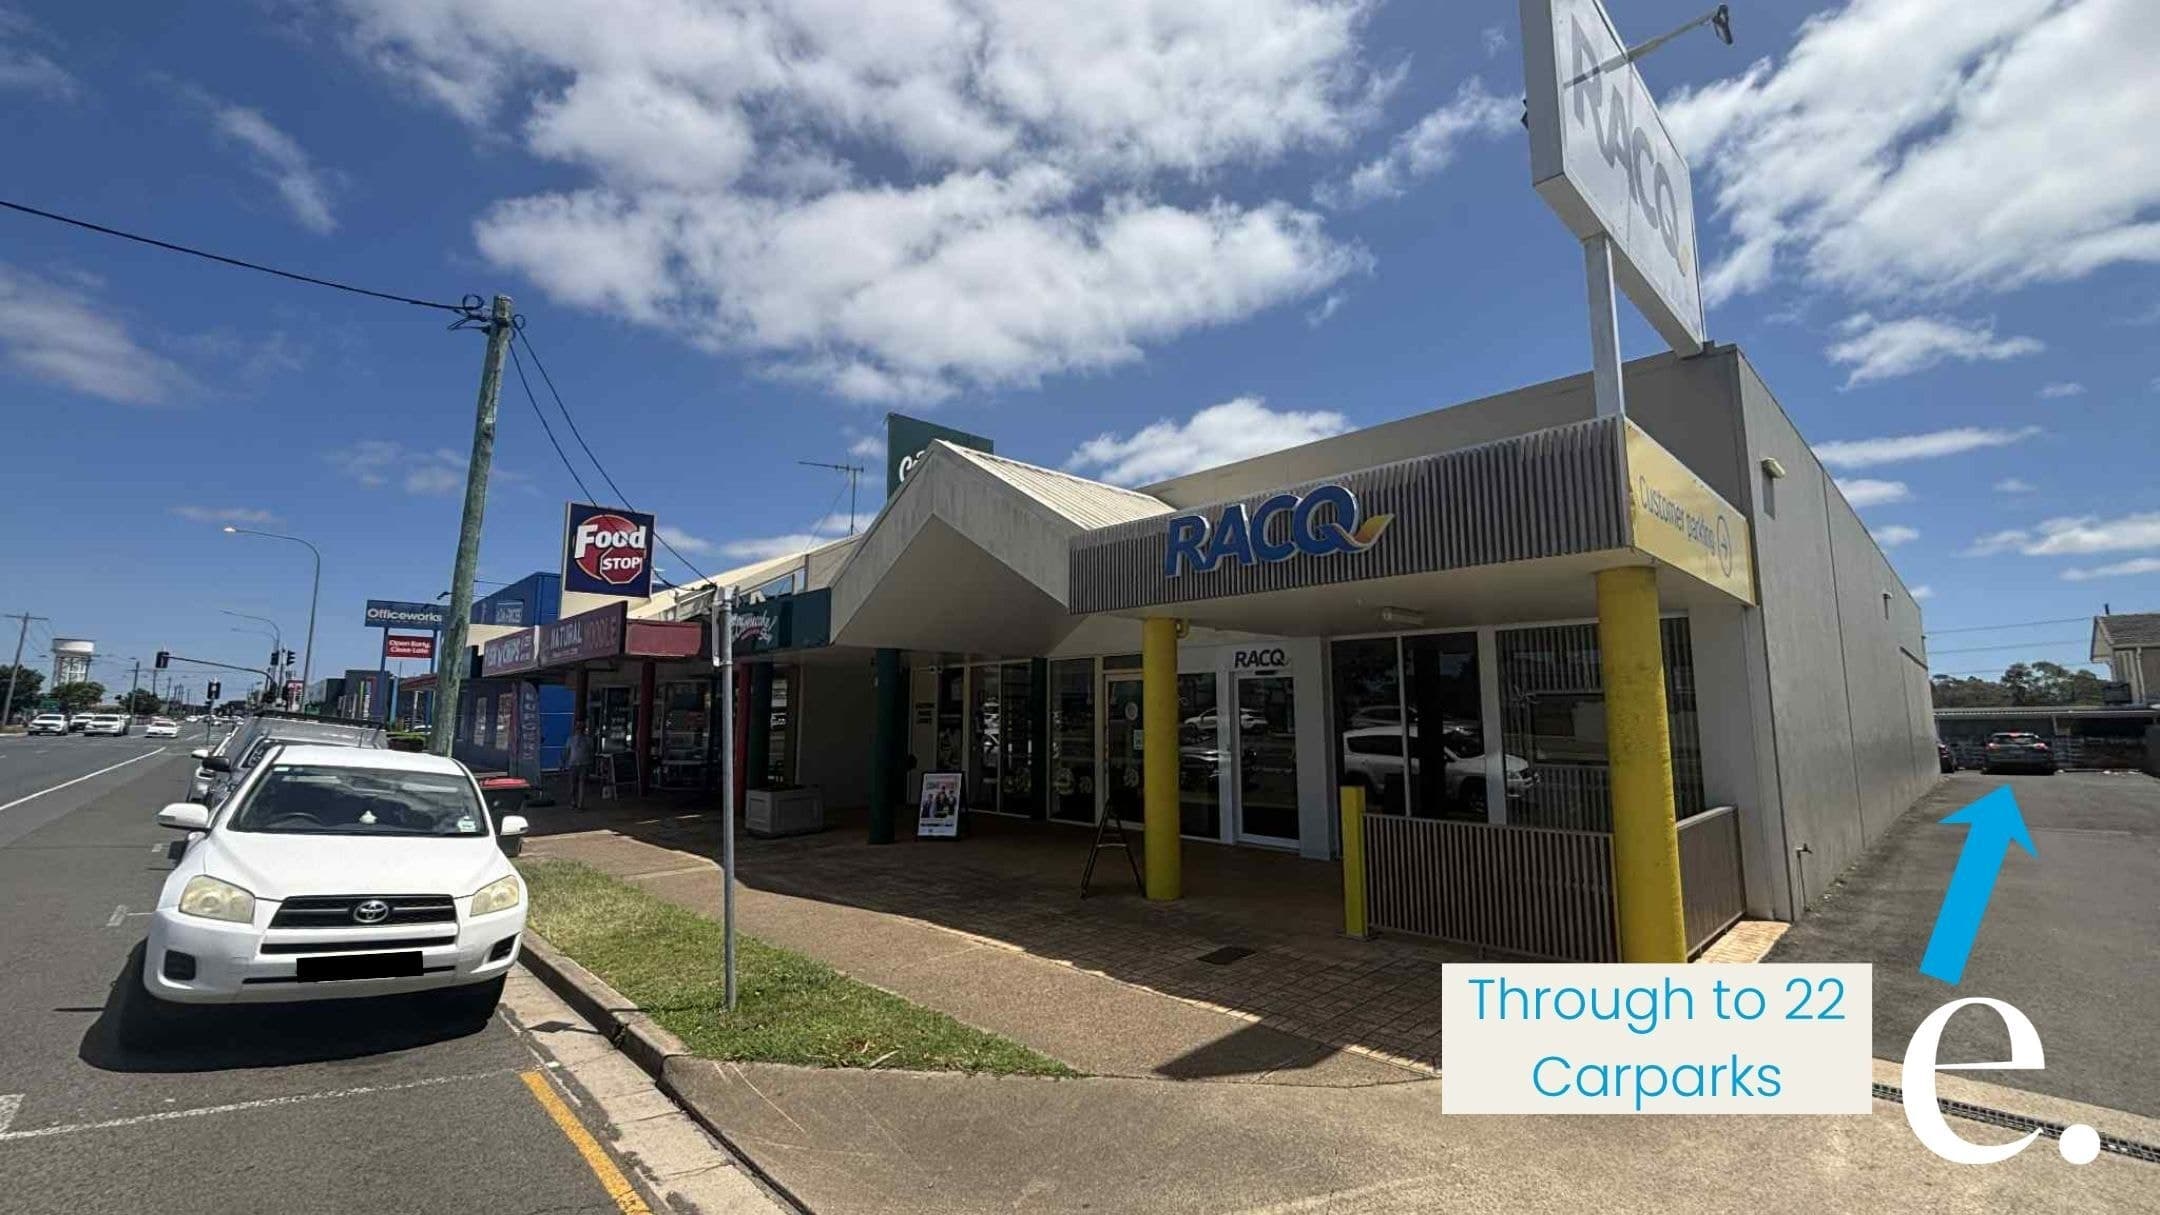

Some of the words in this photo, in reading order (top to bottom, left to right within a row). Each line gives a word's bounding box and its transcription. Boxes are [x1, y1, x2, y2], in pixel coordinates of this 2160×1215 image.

[1571, 12, 1685, 277] RACQ
[1165, 484, 1376, 577] RACQ
[1640, 475, 1684, 531] Customer
[1686, 512, 1715, 556] parking
[574, 524, 647, 559] Food
[602, 556, 641, 571] STOP
[367, 608, 442, 622] Officeworks
[1234, 648, 1286, 668] RACQ
